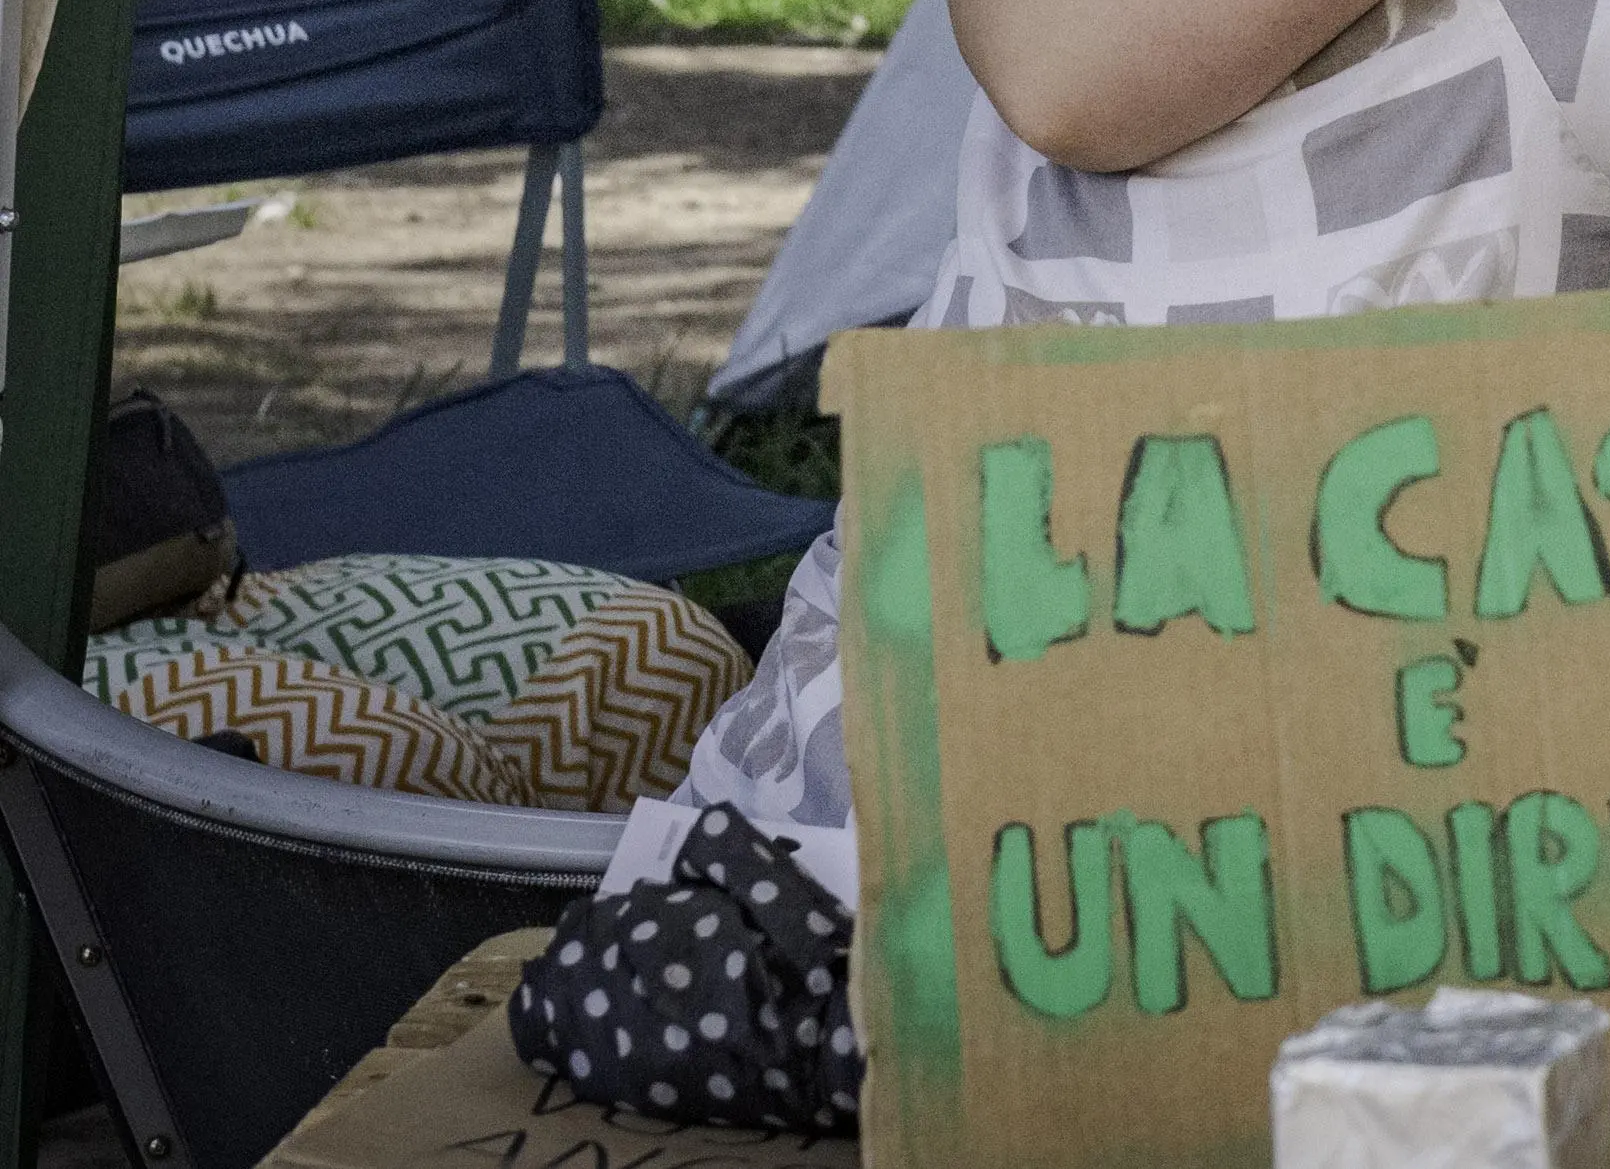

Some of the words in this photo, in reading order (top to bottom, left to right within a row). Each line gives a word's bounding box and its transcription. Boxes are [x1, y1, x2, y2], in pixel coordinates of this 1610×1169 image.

[159, 19, 309, 65] QUECHUA
[979, 430, 1258, 664] LA
[990, 806, 1280, 1020] UN
